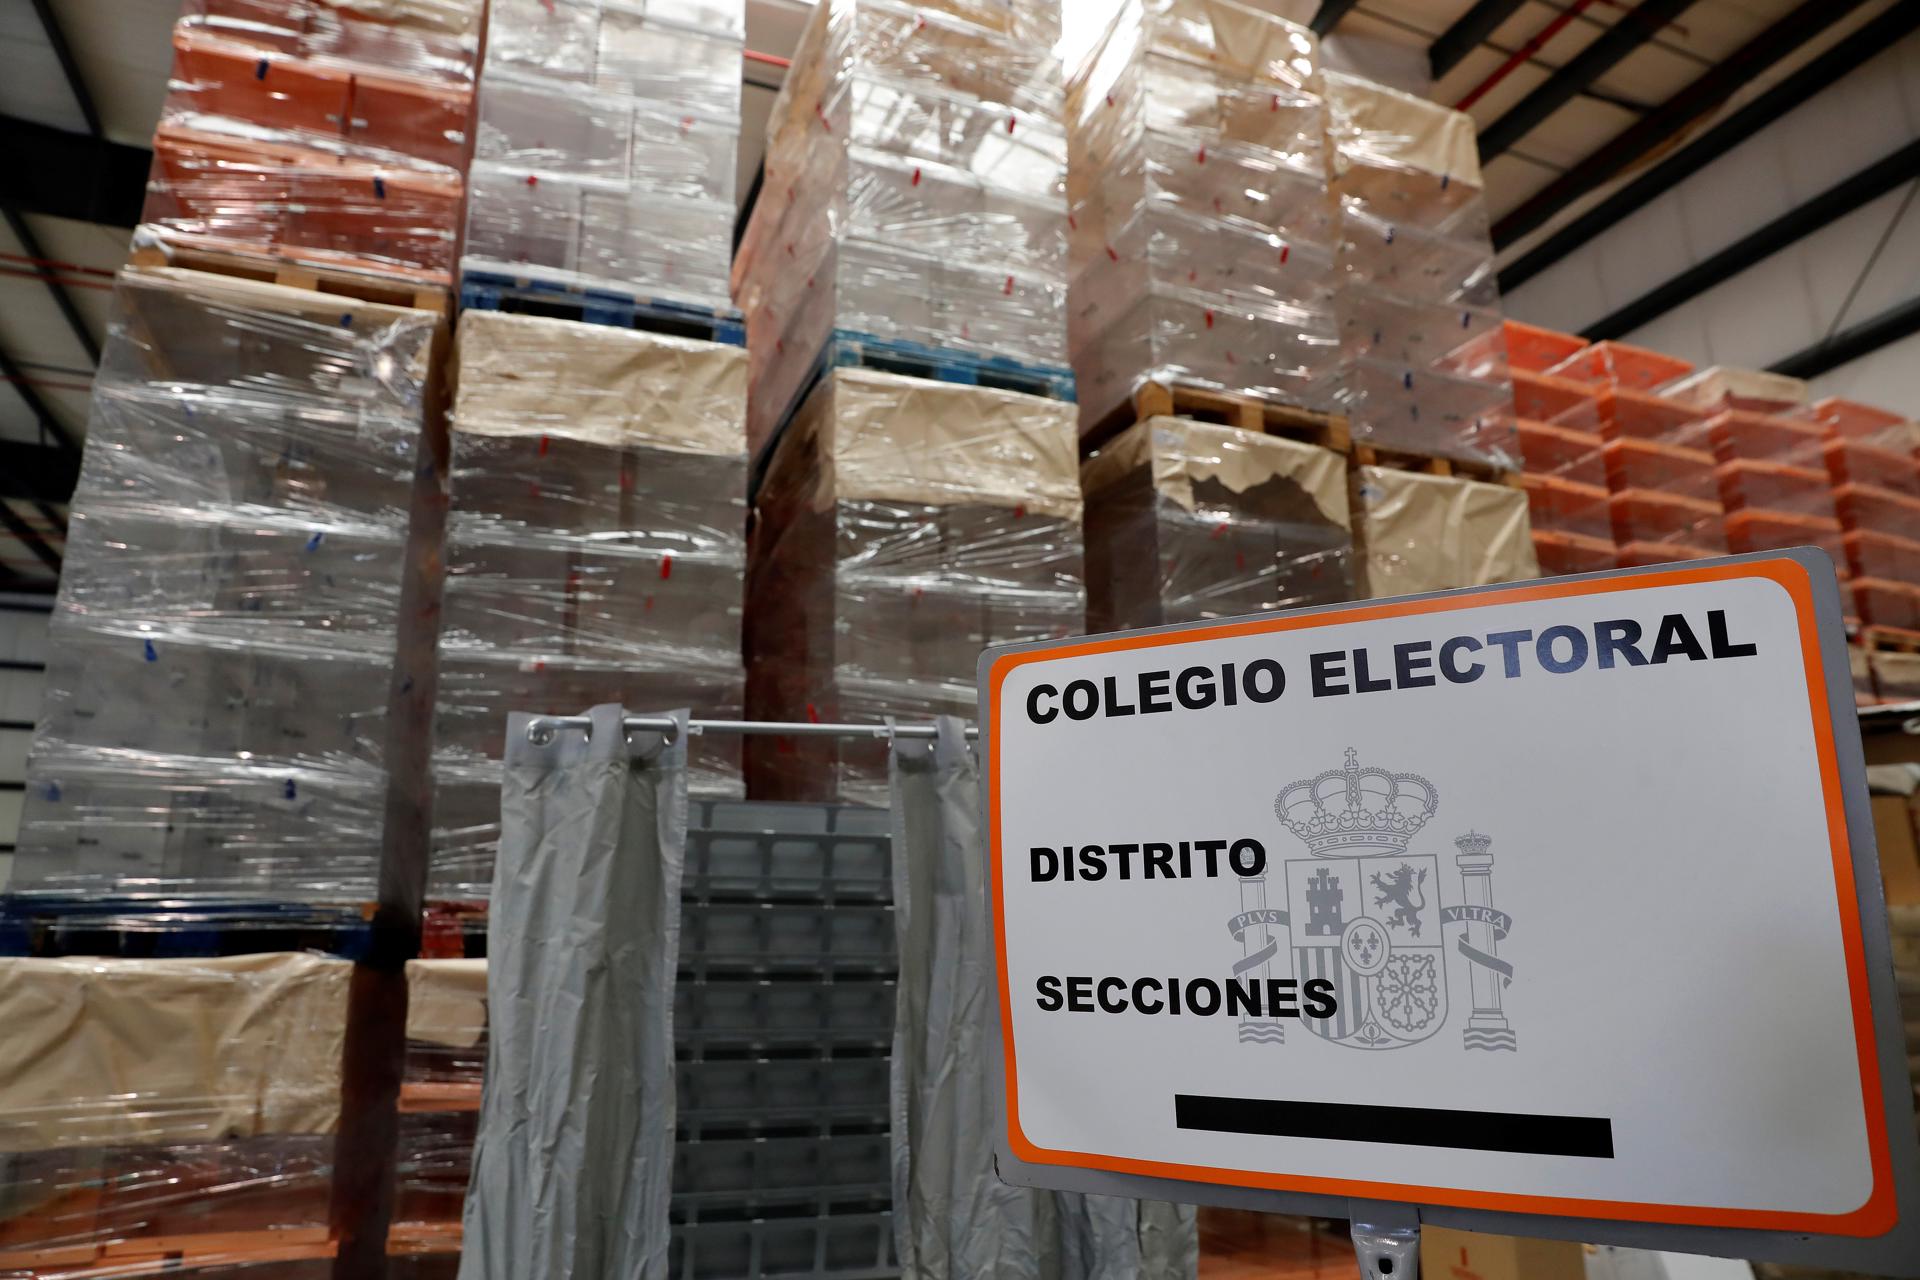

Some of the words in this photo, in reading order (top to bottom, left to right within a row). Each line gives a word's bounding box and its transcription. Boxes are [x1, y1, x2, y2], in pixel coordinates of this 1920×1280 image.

[1026, 658, 1286, 725] COLEGIO
[1309, 609, 1758, 698] ELECTORAL
[1030, 838, 1267, 883] DISTRITO
[1237, 911, 1278, 928] PLVS
[1447, 906, 1505, 929] VLTRA
[1036, 975, 1338, 1019] SECCIONES
